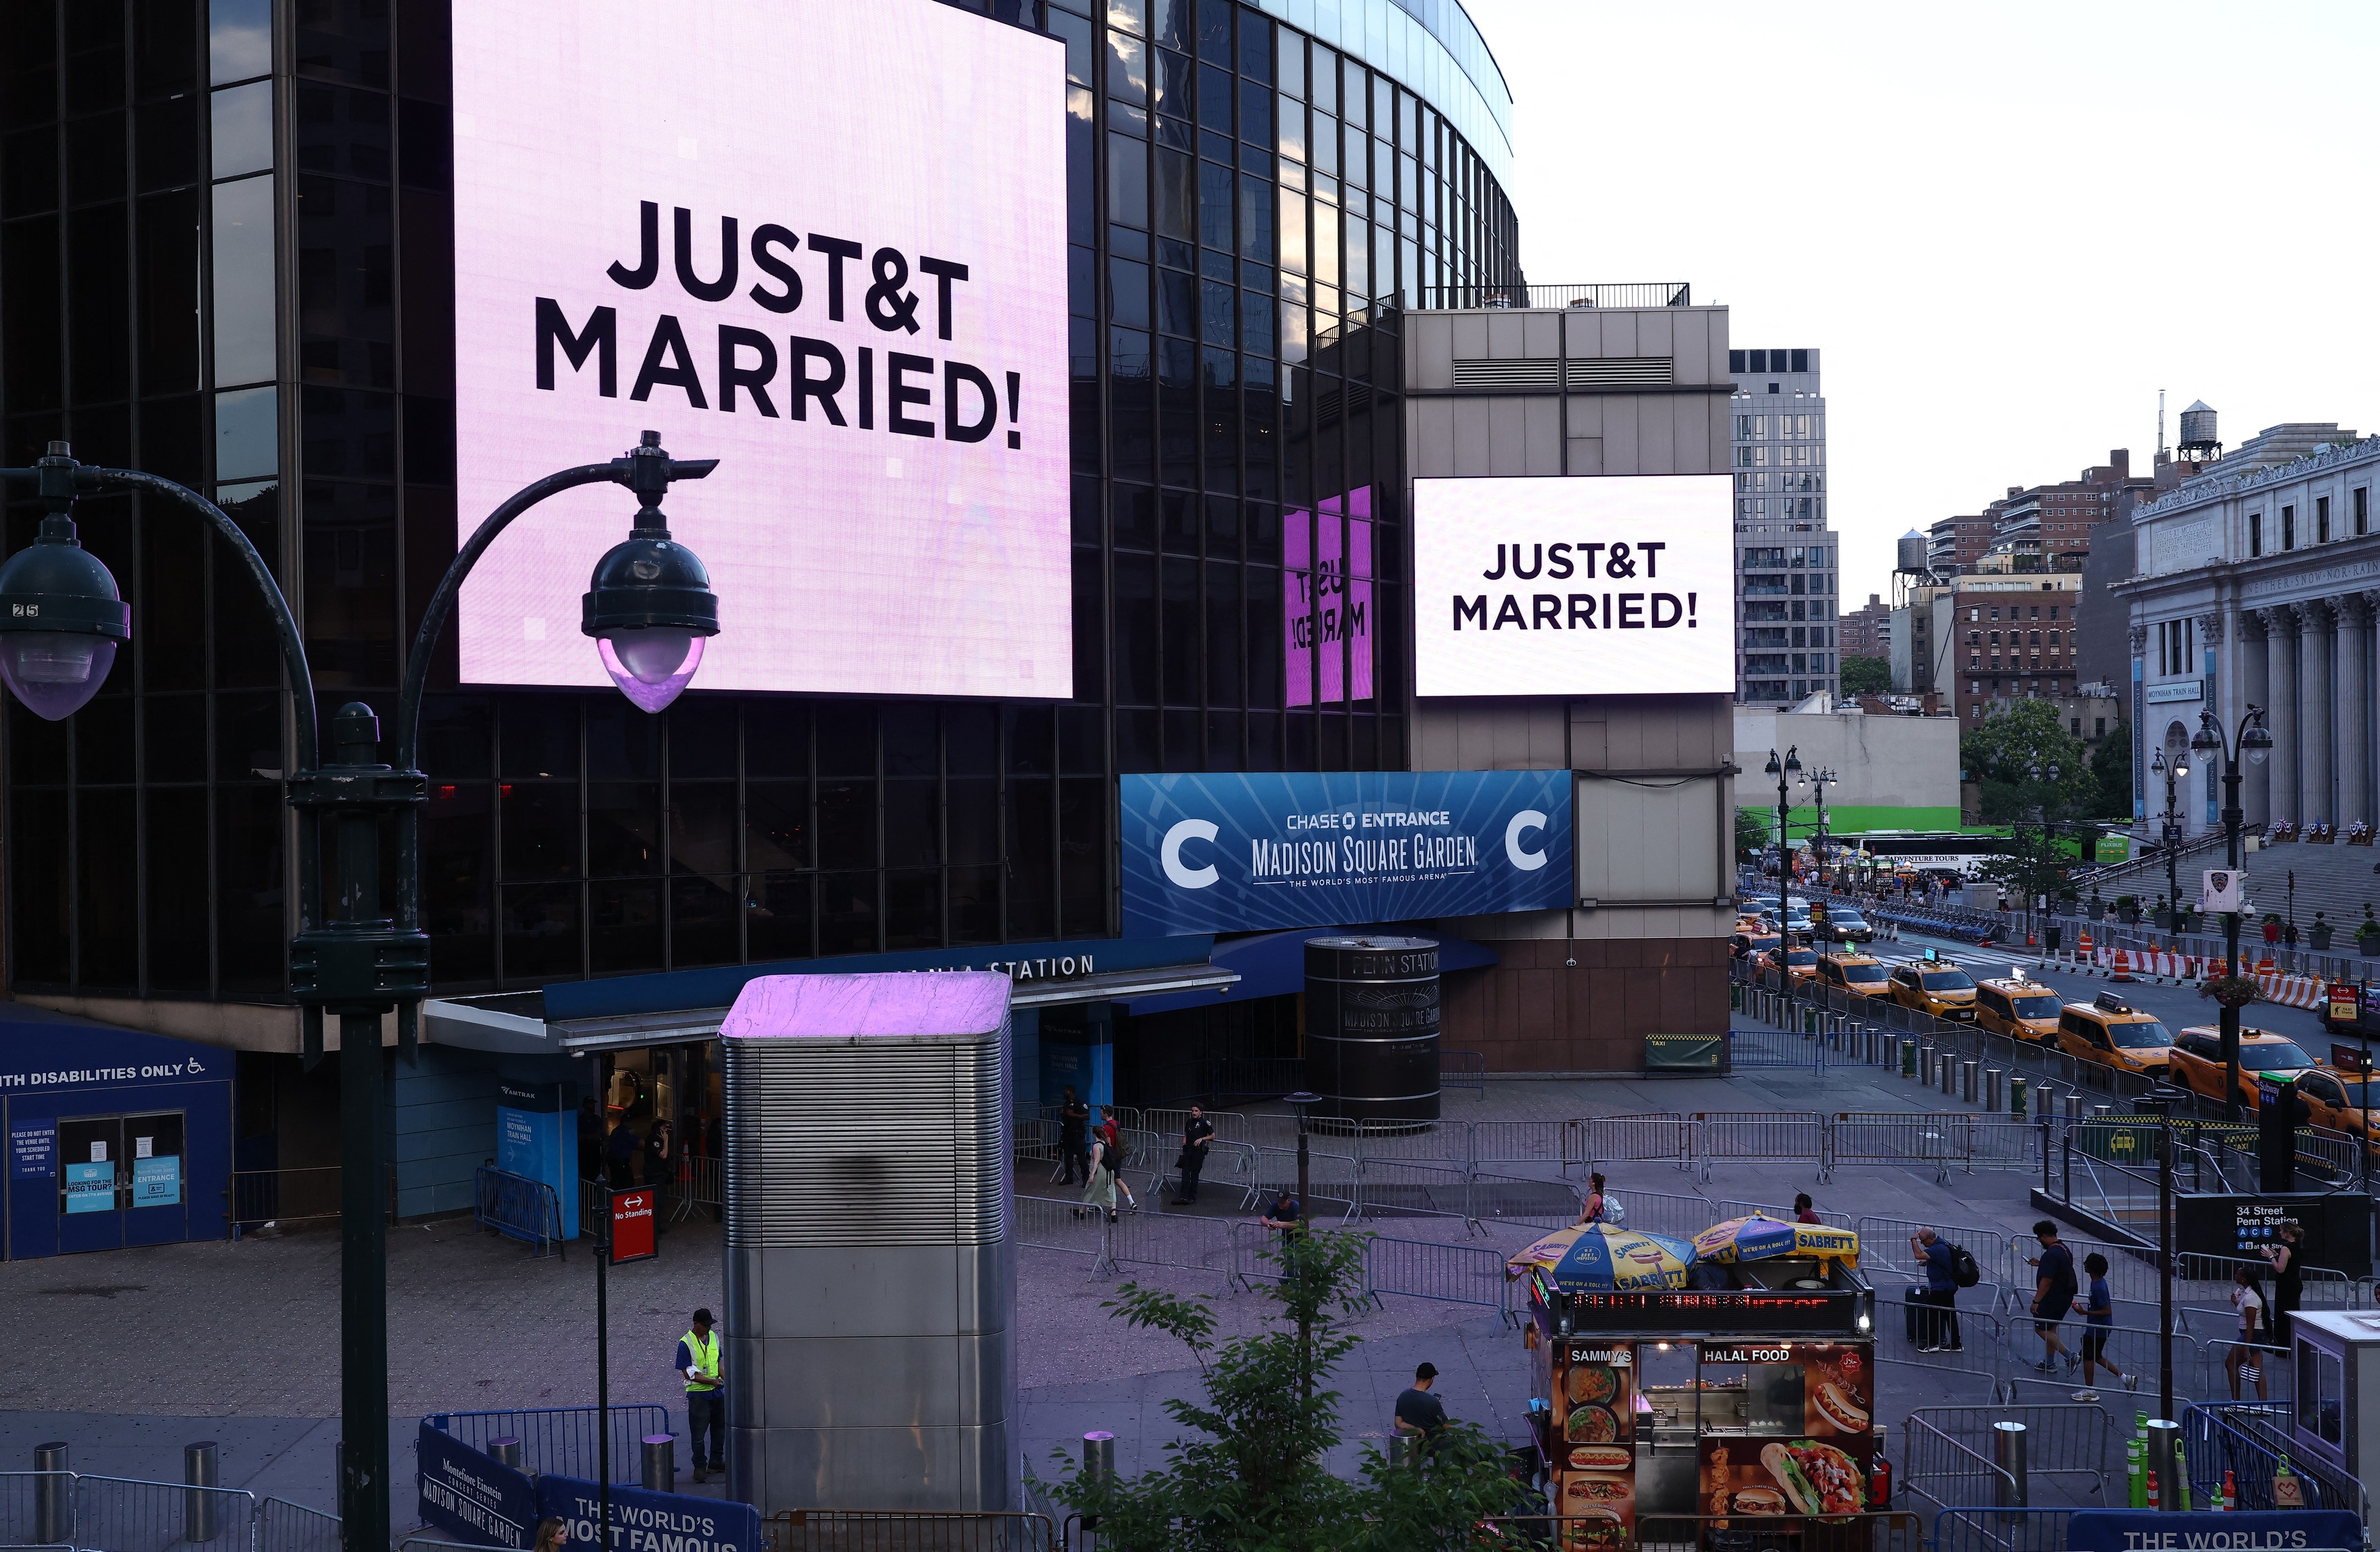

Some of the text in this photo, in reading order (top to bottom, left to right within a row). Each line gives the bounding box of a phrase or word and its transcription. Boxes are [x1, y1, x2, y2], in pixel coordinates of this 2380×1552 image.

[607, 200, 968, 341] JUST&T
[535, 296, 1021, 450] MARRIED!
[1483, 542, 1665, 580] JUST&T
[13, 603, 39, 617] 25
[1453, 592, 1697, 630] MARRIED!
[2149, 689, 2172, 698] MOYNIHAN
[1287, 811, 1450, 830] CHASE ENTRANCE
[1506, 810, 1549, 871] C
[1160, 818, 1221, 889] C
[1252, 838, 1336, 877] MADISON
[1343, 835, 1408, 875] SQUARE
[1310, 877, 1351, 886] WORLD'S
[1382, 874, 1416, 882] FAMOUS
[991, 954, 1093, 979] STATION
[1400, 950, 1439, 973] STATION
[31, 1066, 136, 1085] DISABILITIES
[141, 1063, 183, 1078] ONLY
[508, 1090, 535, 1099] AMTRAK
[2259, 1081, 2280, 1097] Subway
[507, 1122, 532, 1133] MOYNIHAN
[507, 1130, 519, 1140] TRAIN
[520, 1133, 532, 1142] HALL
[138, 1174, 175, 1183] ENTRANCE
[88, 1183, 112, 1191] TOUR?
[625, 1209, 652, 1218] Standing
[2237, 1207, 2284, 1215] 34 Street
[2237, 1217, 2260, 1226] Penn
[1530, 1243, 1570, 1253] SABRETT
[1743, 1245, 1758, 1253] WE'RE
[1798, 1234, 1855, 1249] SABRETT
[1613, 1241, 1651, 1259] SABRETT
[1571, 1350, 1632, 1363] SAMMY'S
[1705, 1350, 1790, 1362] HALAL FOOD
[442, 1458, 502, 1501] Montefiore Einstein
[448, 1475, 497, 1510] CONCERT SERIES
[423, 1479, 521, 1549] MADISON SQUARE GARDEN
[1580, 1503, 1617, 1511] CHEESEBURGER
[575, 1497, 715, 1537] THE WORLD'S
[2123, 1530, 2307, 1550] THE WORLD'S
